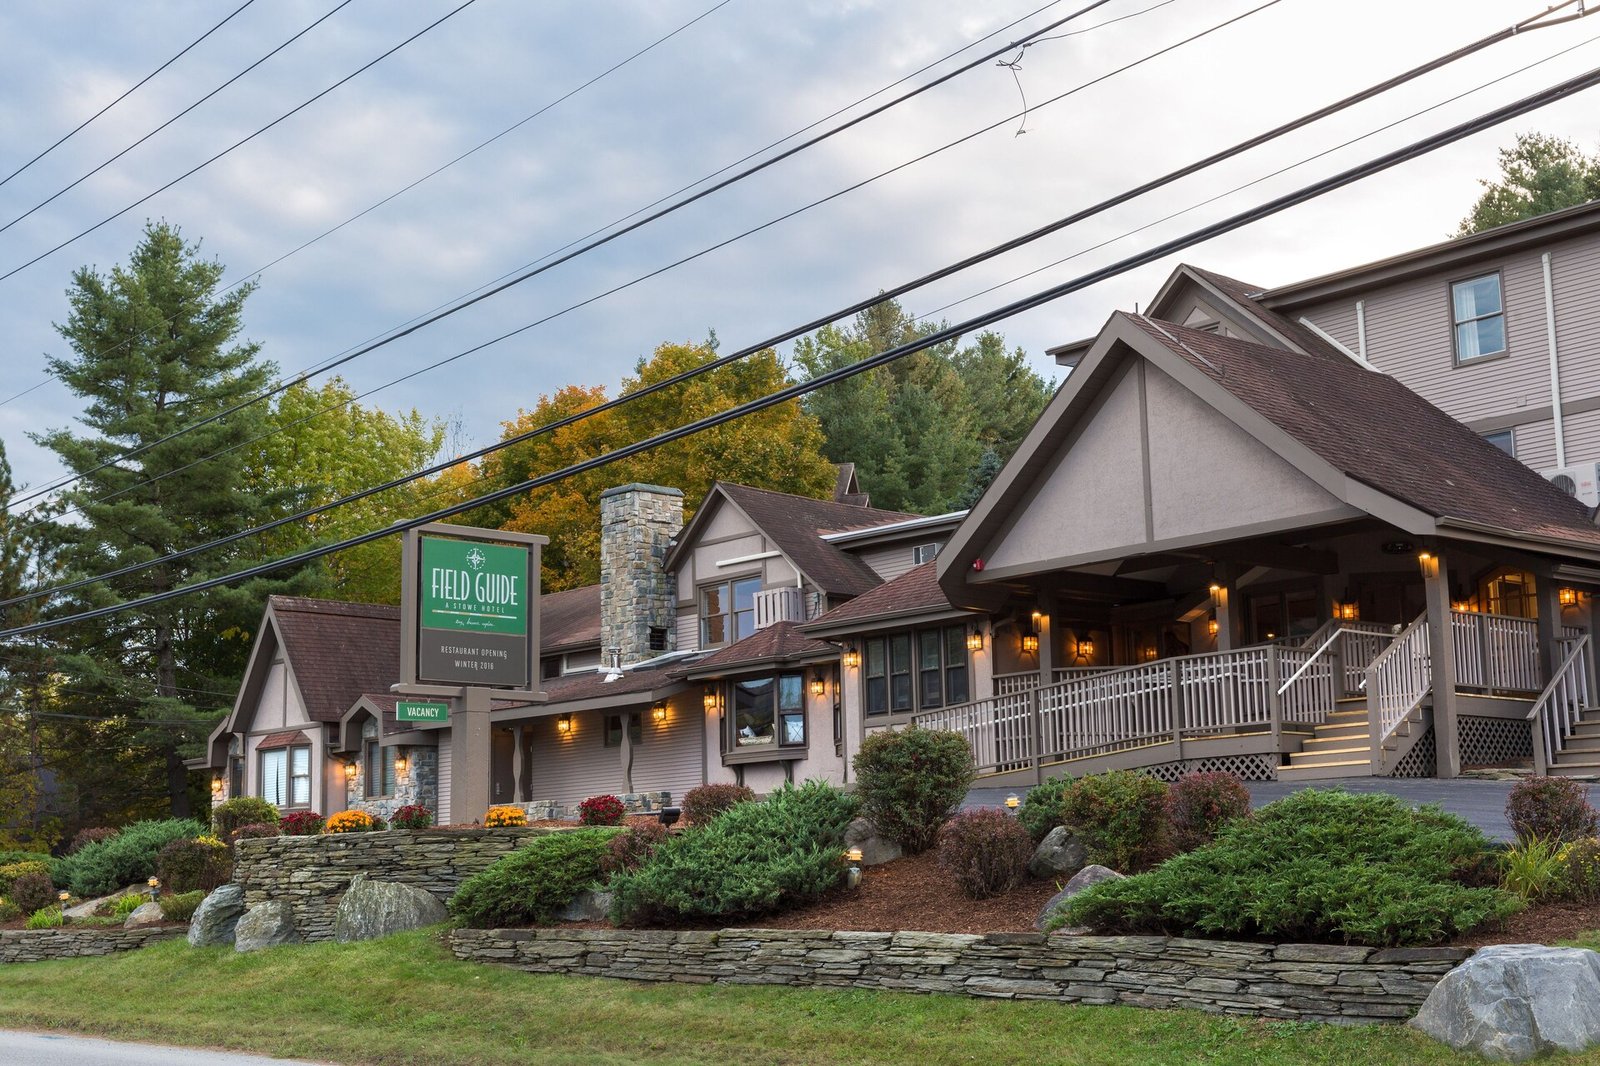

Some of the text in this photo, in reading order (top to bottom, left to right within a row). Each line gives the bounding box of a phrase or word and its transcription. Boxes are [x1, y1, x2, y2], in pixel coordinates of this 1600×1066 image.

[432, 568, 518, 605] FIELD GUIDE
[453, 603, 477, 611] STOWE
[481, 605, 505, 613] HOTEL
[440, 645, 508, 660] RESTAURANT OPENING
[454, 660, 478, 670] WINTER
[407, 707, 439, 717] VACANCY
